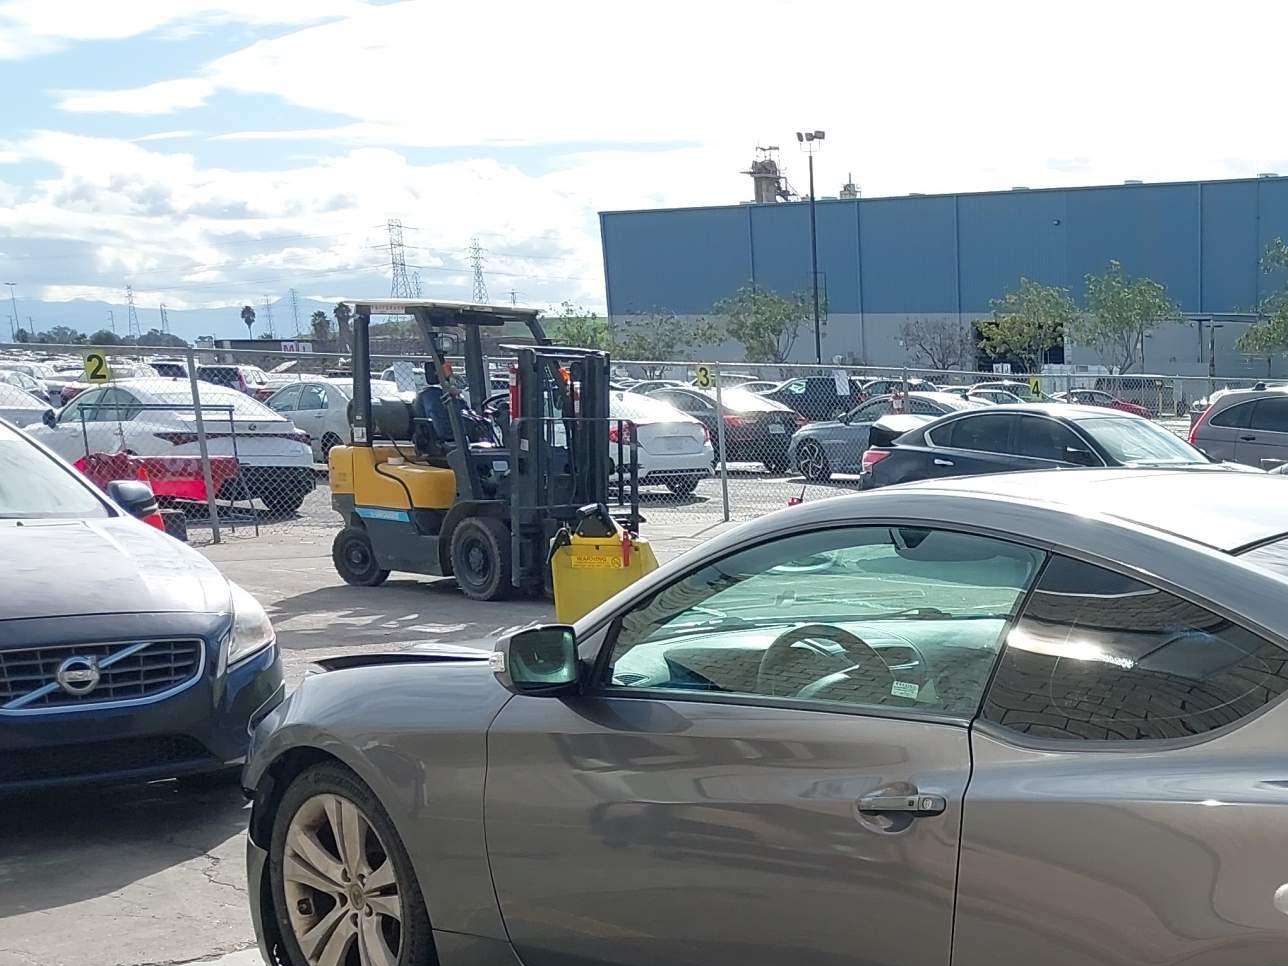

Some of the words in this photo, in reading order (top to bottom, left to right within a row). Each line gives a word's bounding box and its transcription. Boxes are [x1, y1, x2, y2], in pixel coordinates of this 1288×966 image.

[87, 354, 107, 379] 2
[698, 367, 710, 387] 3
[1032, 380, 1041, 398] 4
